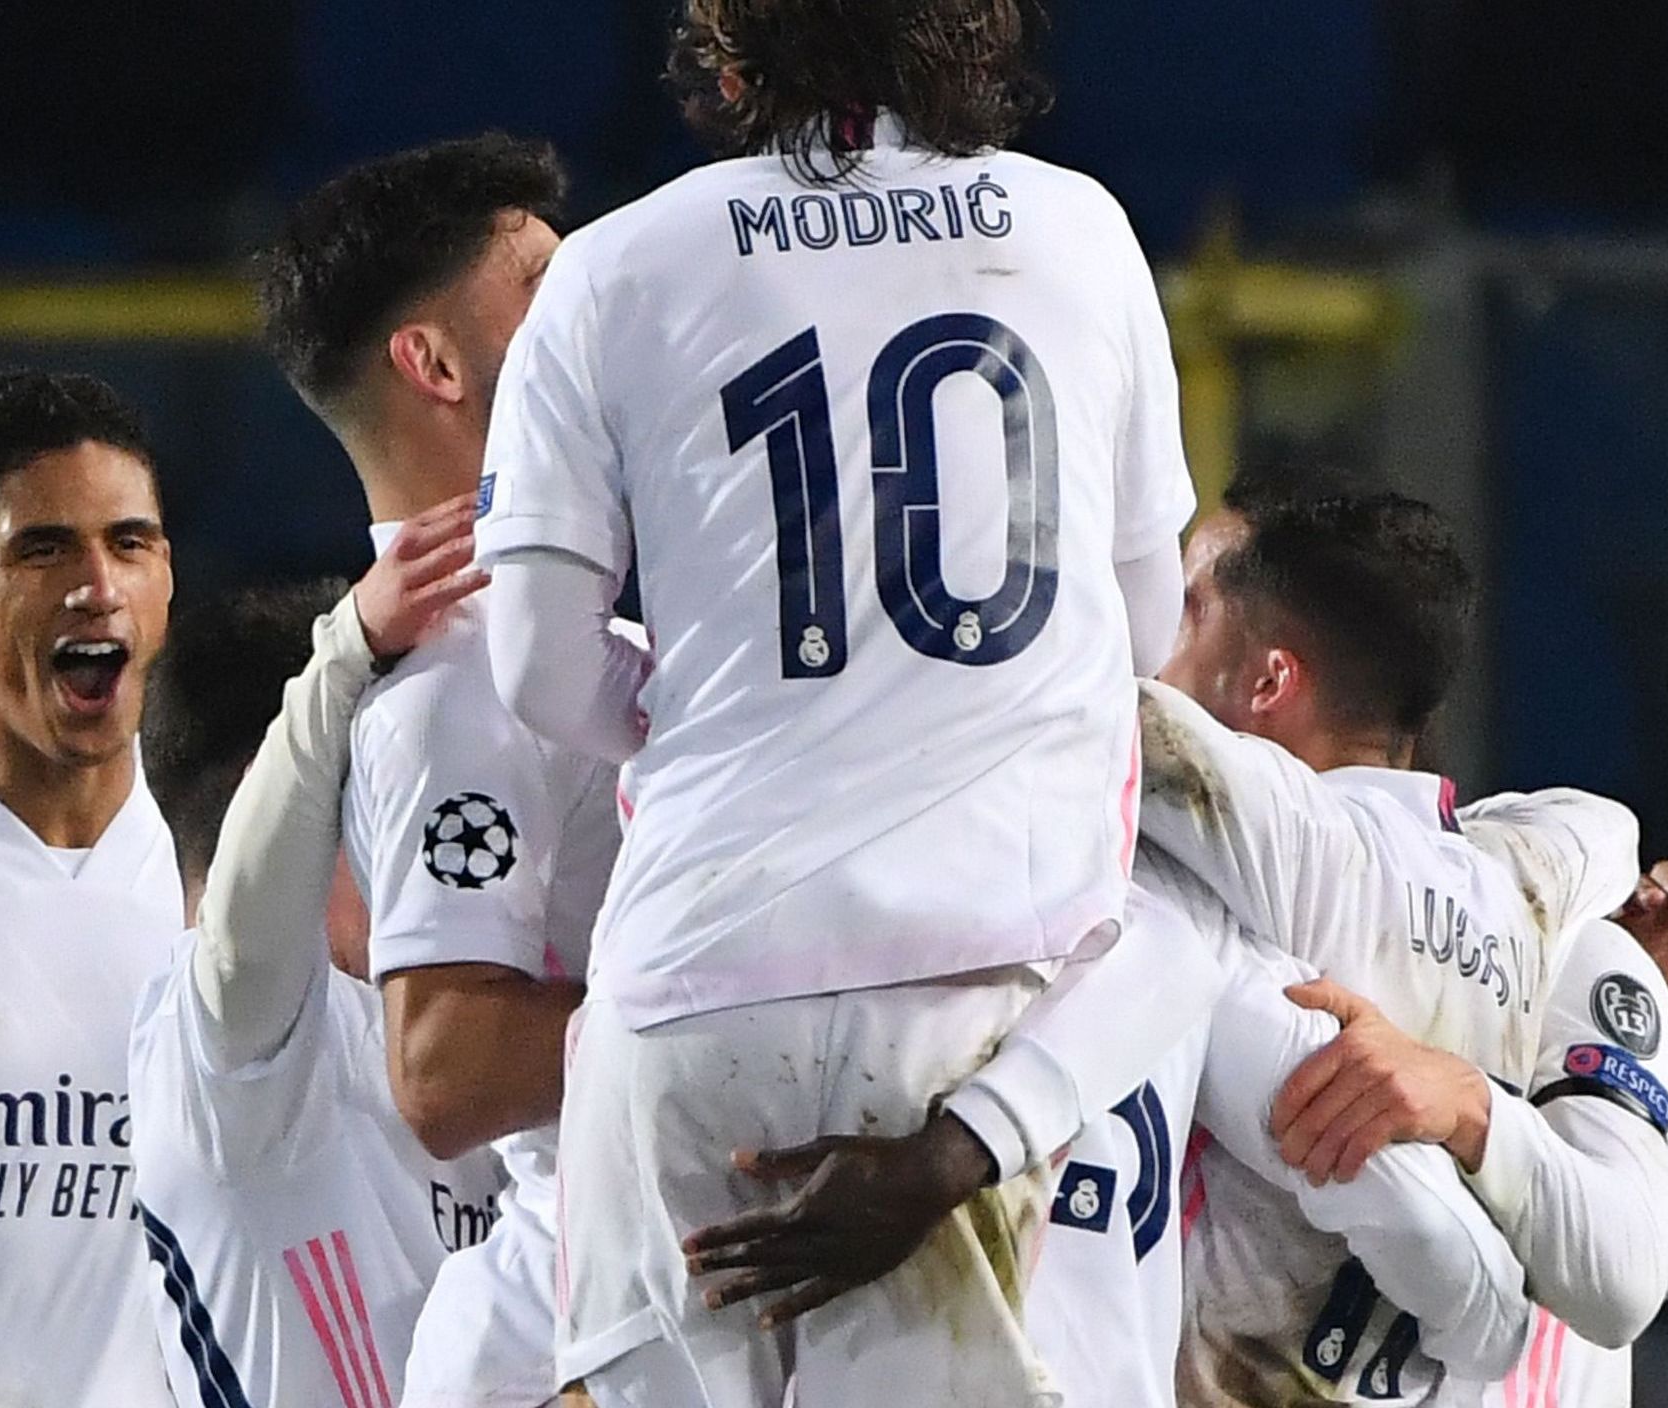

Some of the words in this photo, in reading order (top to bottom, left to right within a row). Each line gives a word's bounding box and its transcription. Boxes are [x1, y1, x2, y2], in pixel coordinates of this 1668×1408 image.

[727, 173, 1012, 256] MODRIĆ
[719, 311, 1060, 680] 10
[1406, 881, 1510, 1007] LUCAS
[1615, 1009, 1647, 1037] 13
[51, 1162, 139, 1221] BET
